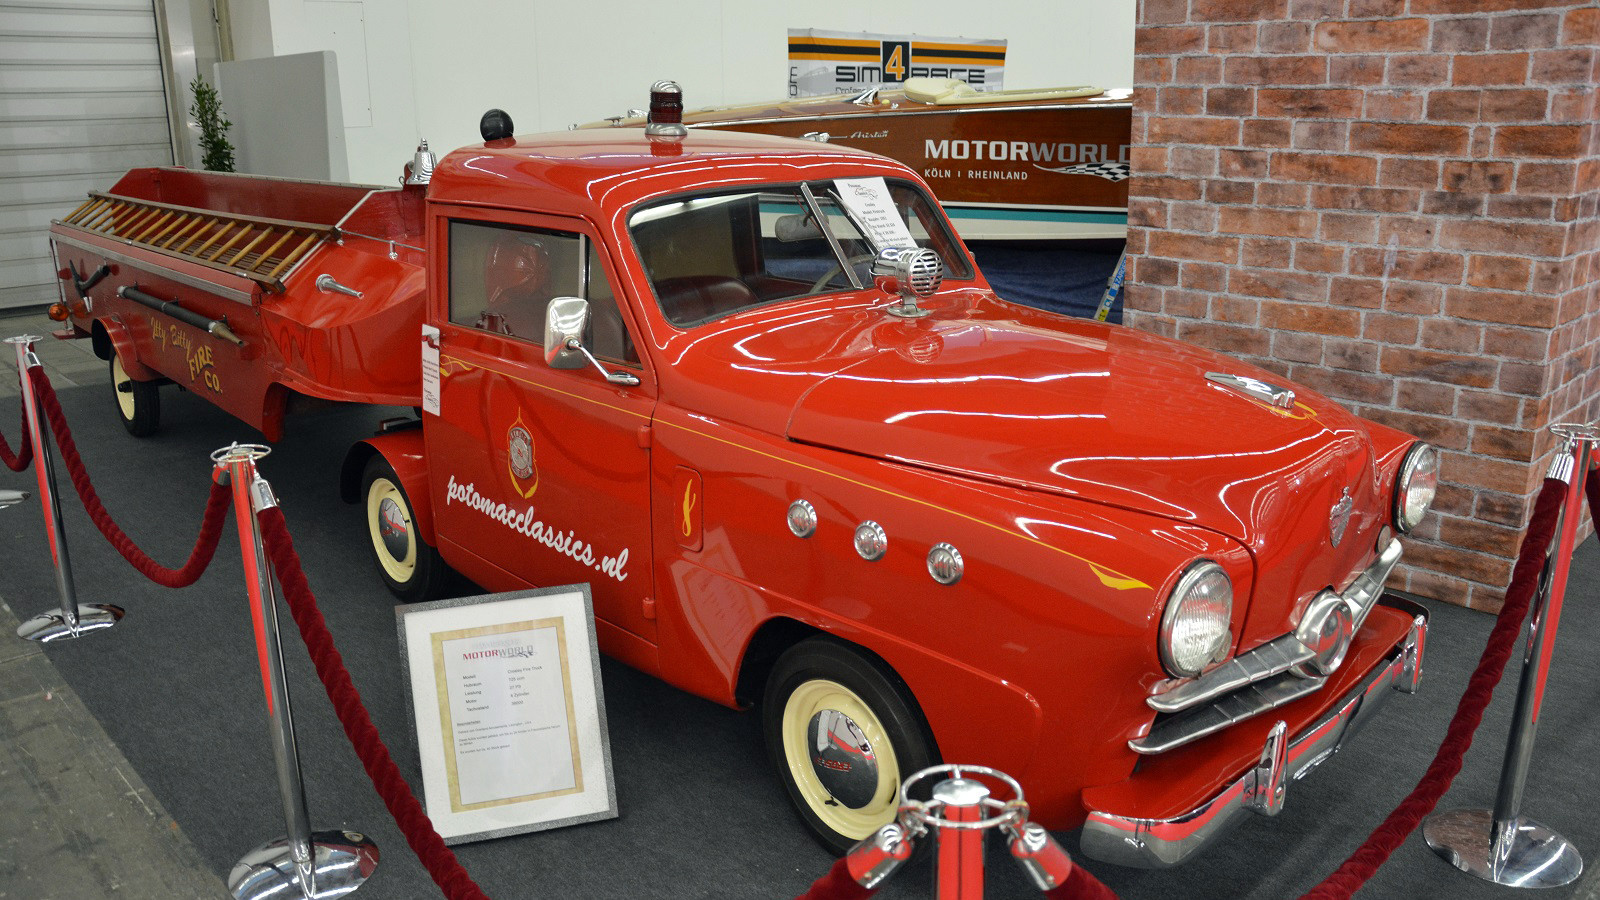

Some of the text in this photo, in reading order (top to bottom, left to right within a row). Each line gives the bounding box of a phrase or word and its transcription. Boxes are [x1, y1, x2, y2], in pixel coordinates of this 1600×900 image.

[924, 167, 951, 178] KÖLN
[968, 170, 1028, 180] RHEINLAND
[189, 345, 214, 381] FIRE
[205, 370, 223, 394] CO.
[447, 475, 629, 581] potomacclassics.nl
[463, 645, 534, 660] MOTORWORLD
